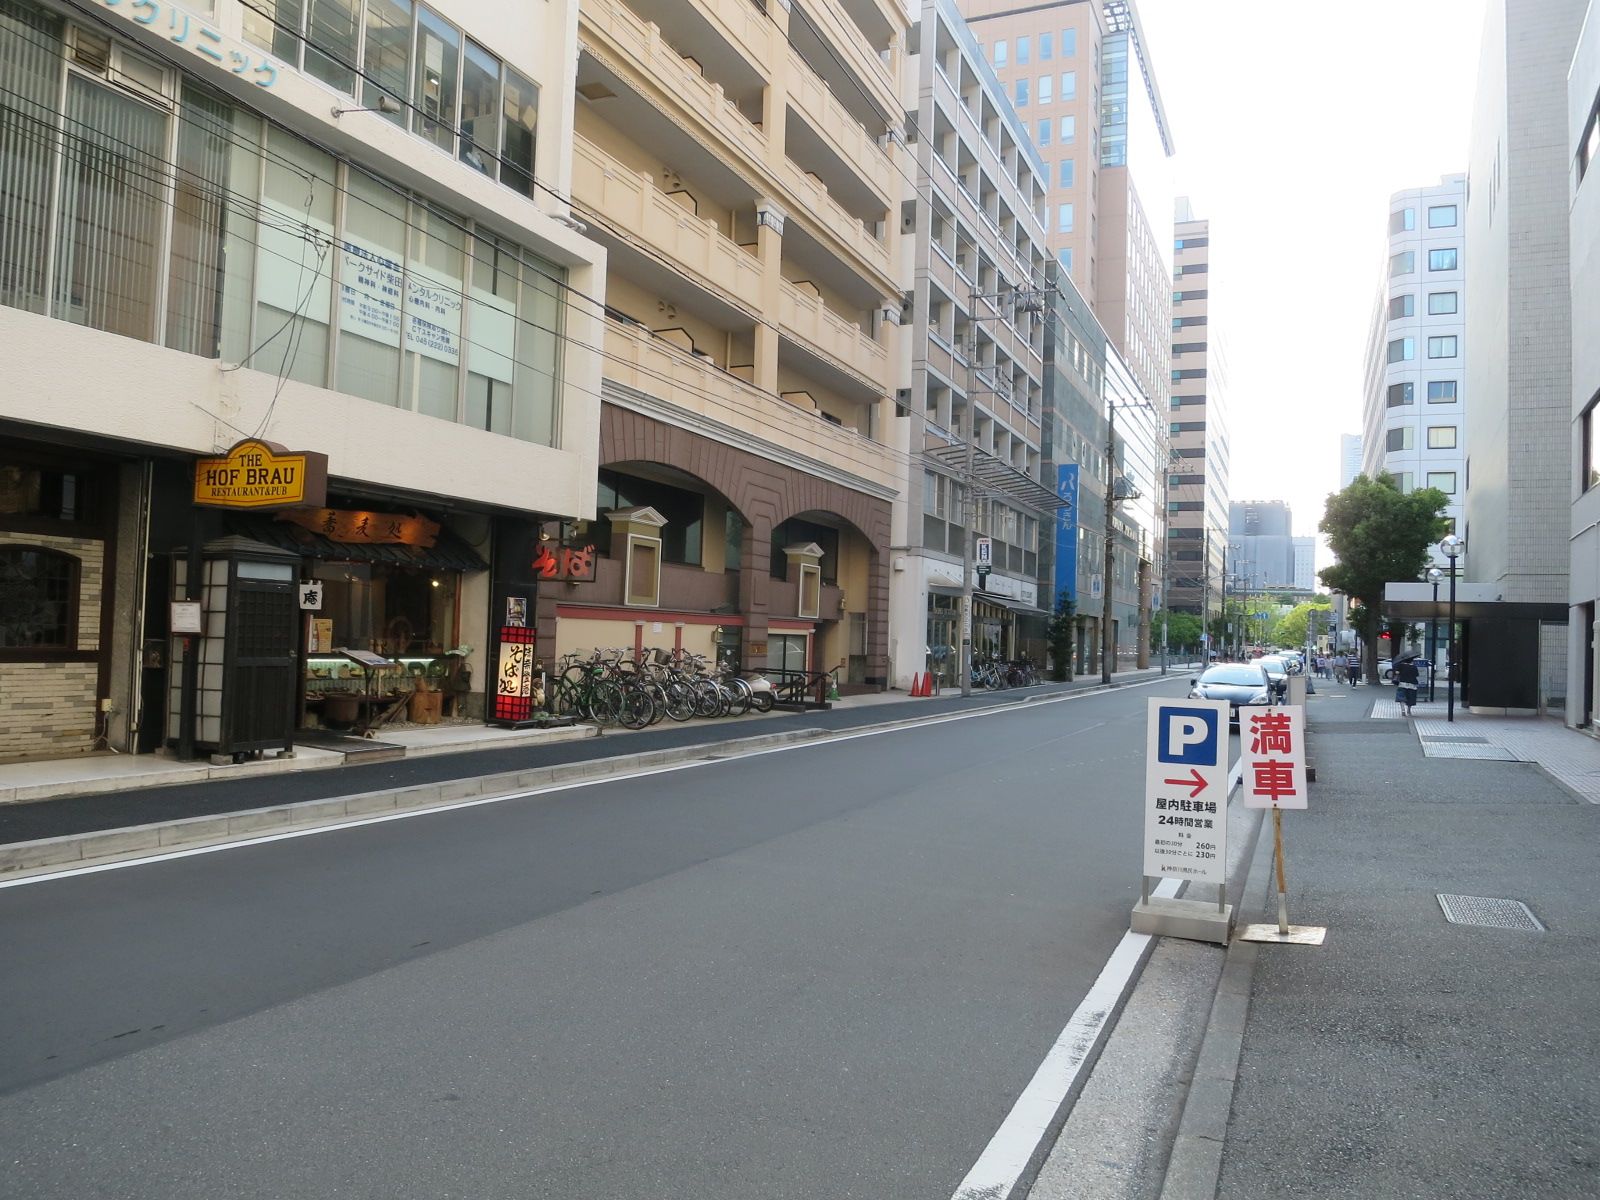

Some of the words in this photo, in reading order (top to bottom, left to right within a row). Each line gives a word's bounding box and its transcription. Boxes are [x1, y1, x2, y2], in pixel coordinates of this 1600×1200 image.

[105, 0, 278, 87] クリニック
[239, 454, 262, 467] THE
[206, 469, 240, 486] HOF
[246, 467, 295, 485] BRAU
[532, 544, 595, 578] そば
[499, 645, 524, 695] そば処
[1168, 715, 1209, 756] P
[1250, 712, 1297, 801] 満車
[1155, 797, 1217, 814] 屋内駐車場
[1158, 815, 1213, 829] 24時間営業
[1195, 851, 1216, 860] 230円
[1196, 842, 1216, 851] 260円
